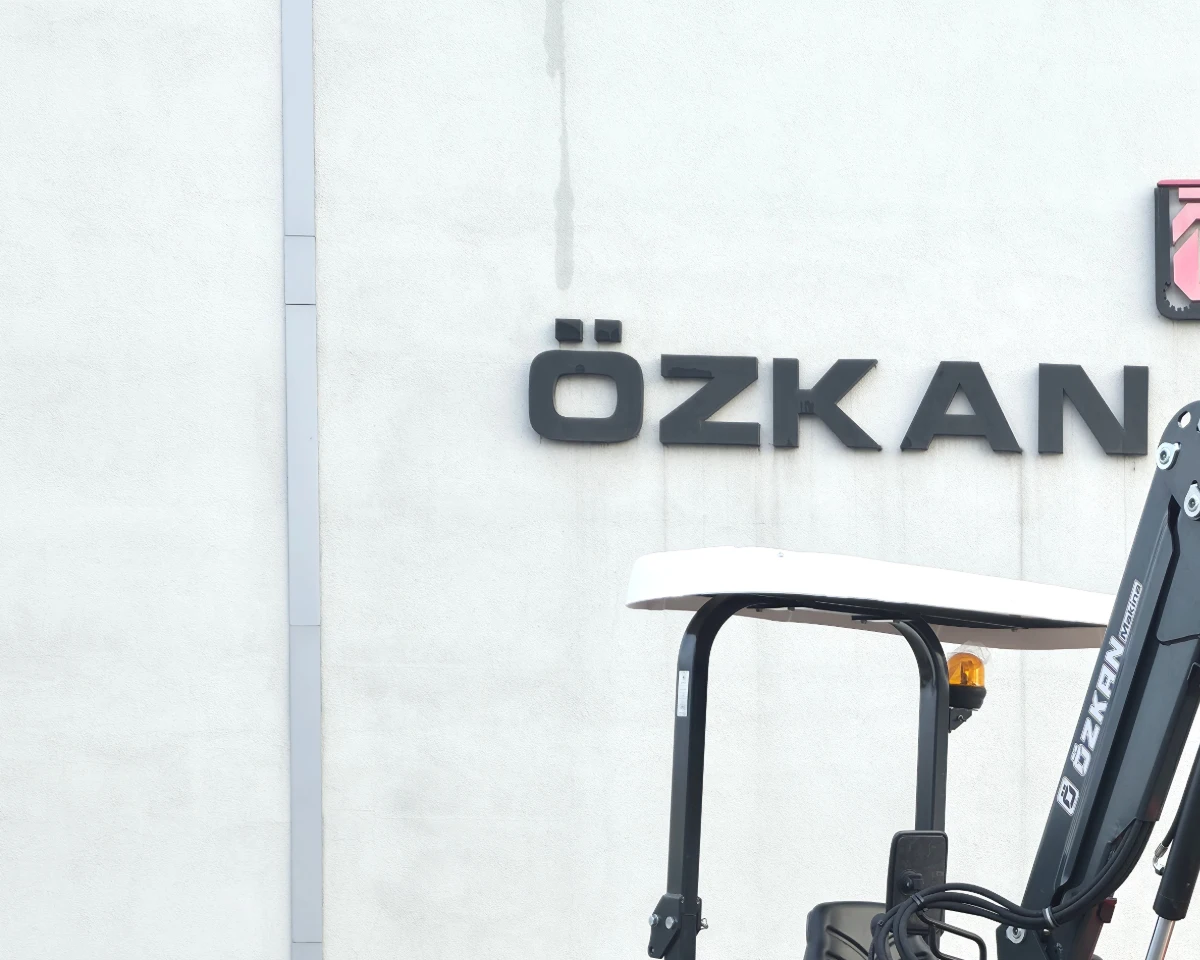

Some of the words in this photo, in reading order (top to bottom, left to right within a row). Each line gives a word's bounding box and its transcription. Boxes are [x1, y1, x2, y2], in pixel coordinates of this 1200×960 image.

[529, 319, 1149, 456] ÖZKAN
[1070, 635, 1126, 777] ÖZKAN
[1120, 581, 1142, 642] Makina
